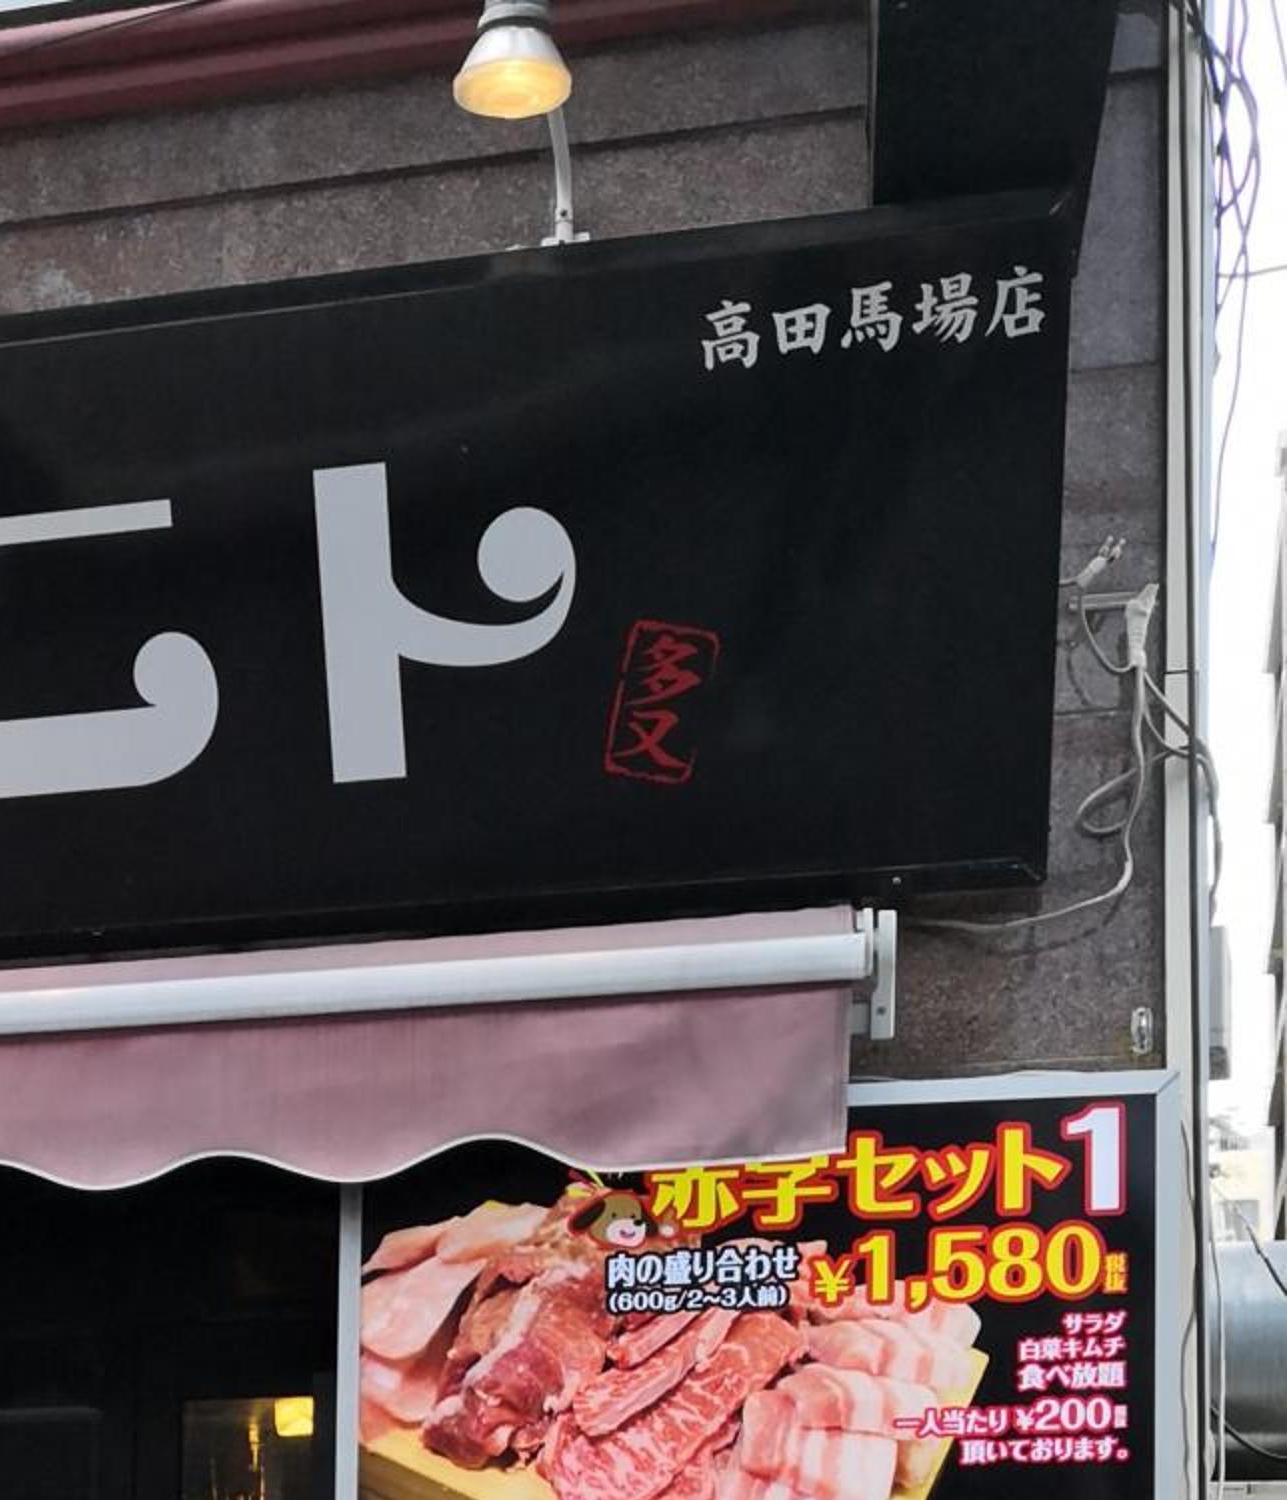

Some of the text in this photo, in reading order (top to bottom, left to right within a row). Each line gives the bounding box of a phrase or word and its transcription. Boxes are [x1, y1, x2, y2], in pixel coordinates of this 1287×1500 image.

[701, 265, 1045, 372] 高田馬場店
[607, 1247, 800, 1288] 肉の盛り合わせ
[1063, 1311, 1127, 1335] サラダ
[1018, 1337, 1127, 1361] 白菜キムチ
[1018, 1361, 1127, 1391] 食べ放題
[961, 1436, 1129, 1465] 頂いております。
